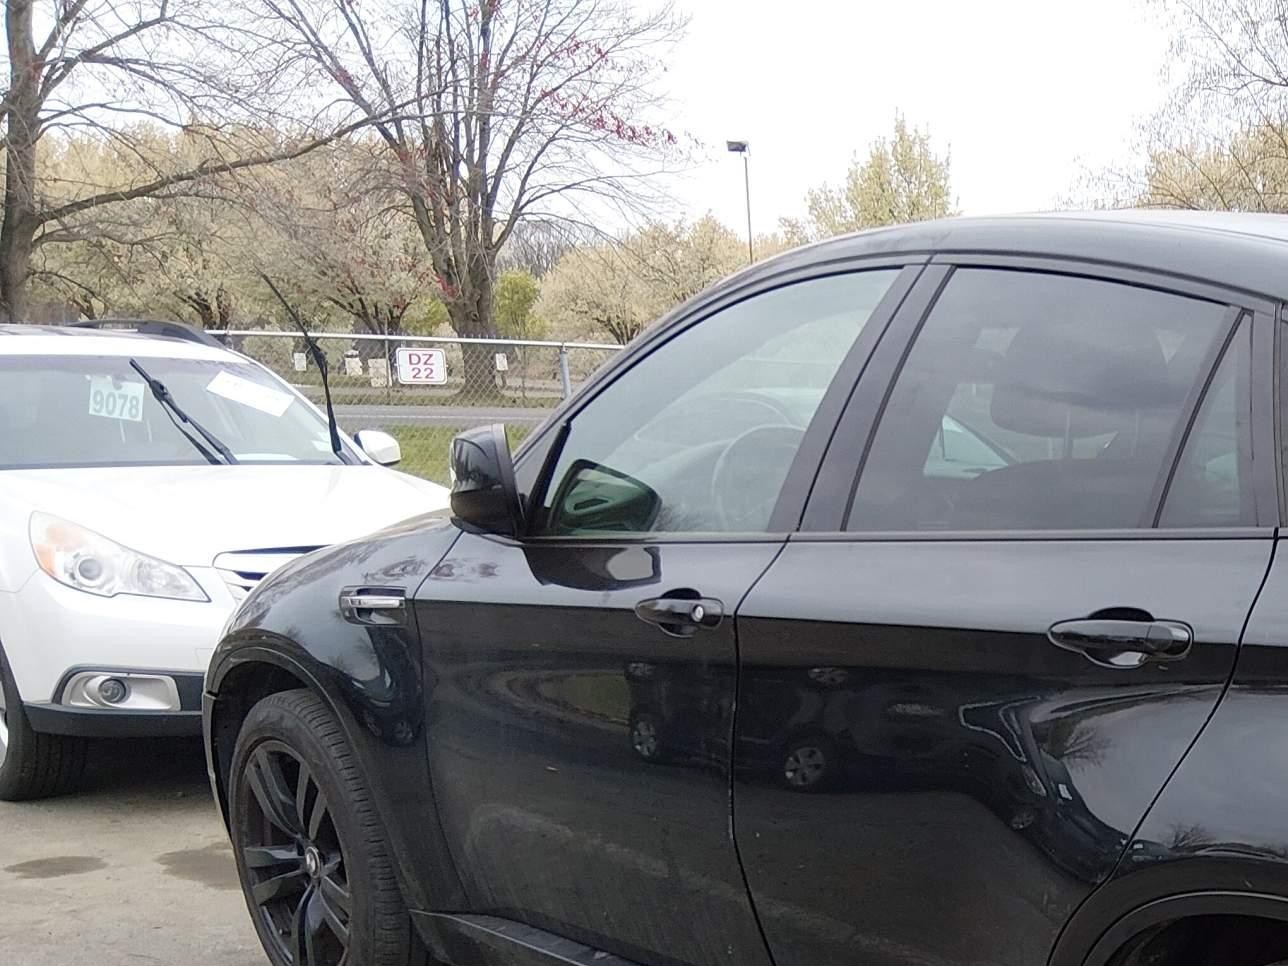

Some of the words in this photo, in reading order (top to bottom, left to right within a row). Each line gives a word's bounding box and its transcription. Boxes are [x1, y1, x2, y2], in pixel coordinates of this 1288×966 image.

[408, 353, 434, 366] DZ
[411, 367, 434, 379] 22
[92, 389, 139, 419] 9078
